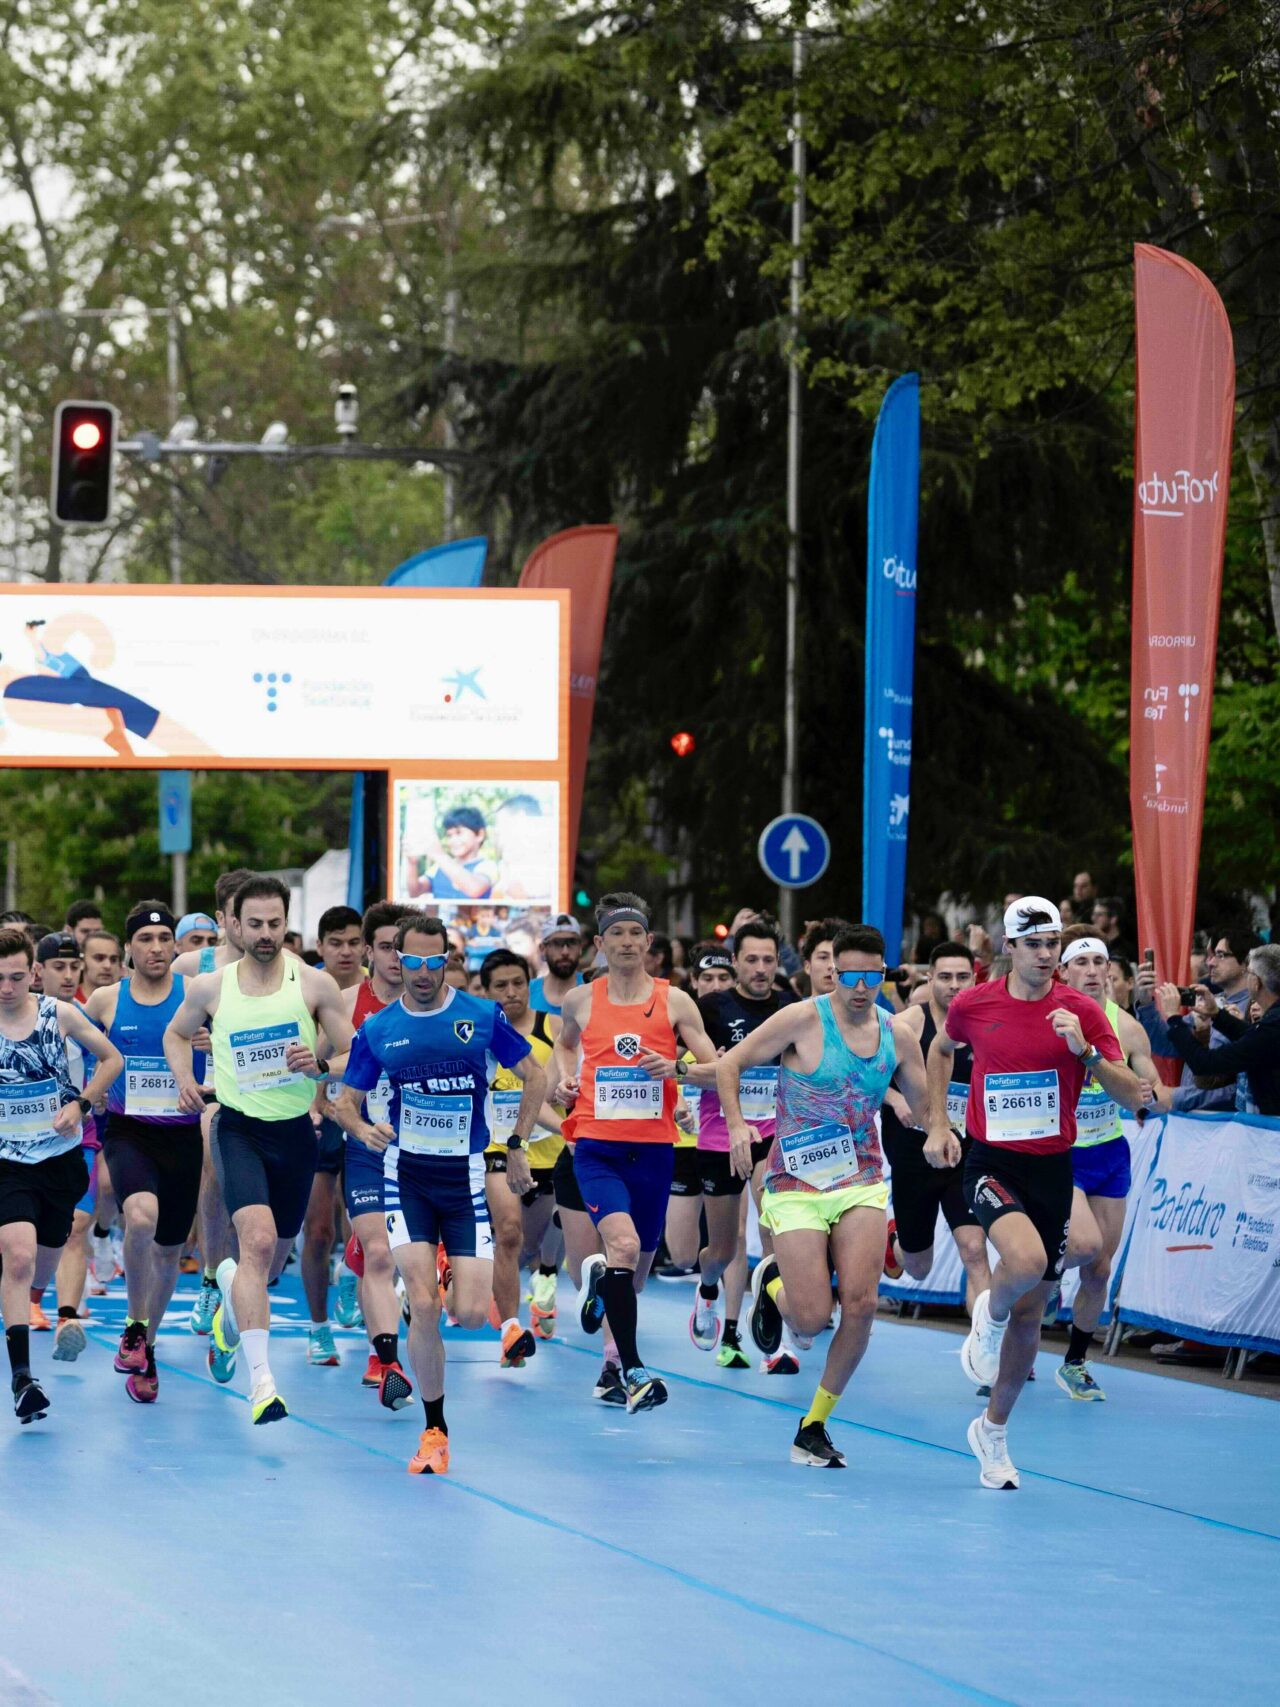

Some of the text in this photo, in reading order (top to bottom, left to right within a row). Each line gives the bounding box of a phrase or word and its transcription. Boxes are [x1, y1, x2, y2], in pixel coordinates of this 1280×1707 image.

[250, 1046, 285, 1062] 25037
[141, 1078, 176, 1089] 26812
[611, 1088, 647, 1099] 26910
[740, 1085, 769, 1096] 26441
[1002, 1096, 1042, 1109] 26618
[10, 1103, 45, 1115] 26833
[1076, 1108, 1106, 1120] 26123
[415, 1115, 454, 1129] 27066
[801, 1145, 838, 1166] 26964
[354, 1195, 379, 1205] ADM
